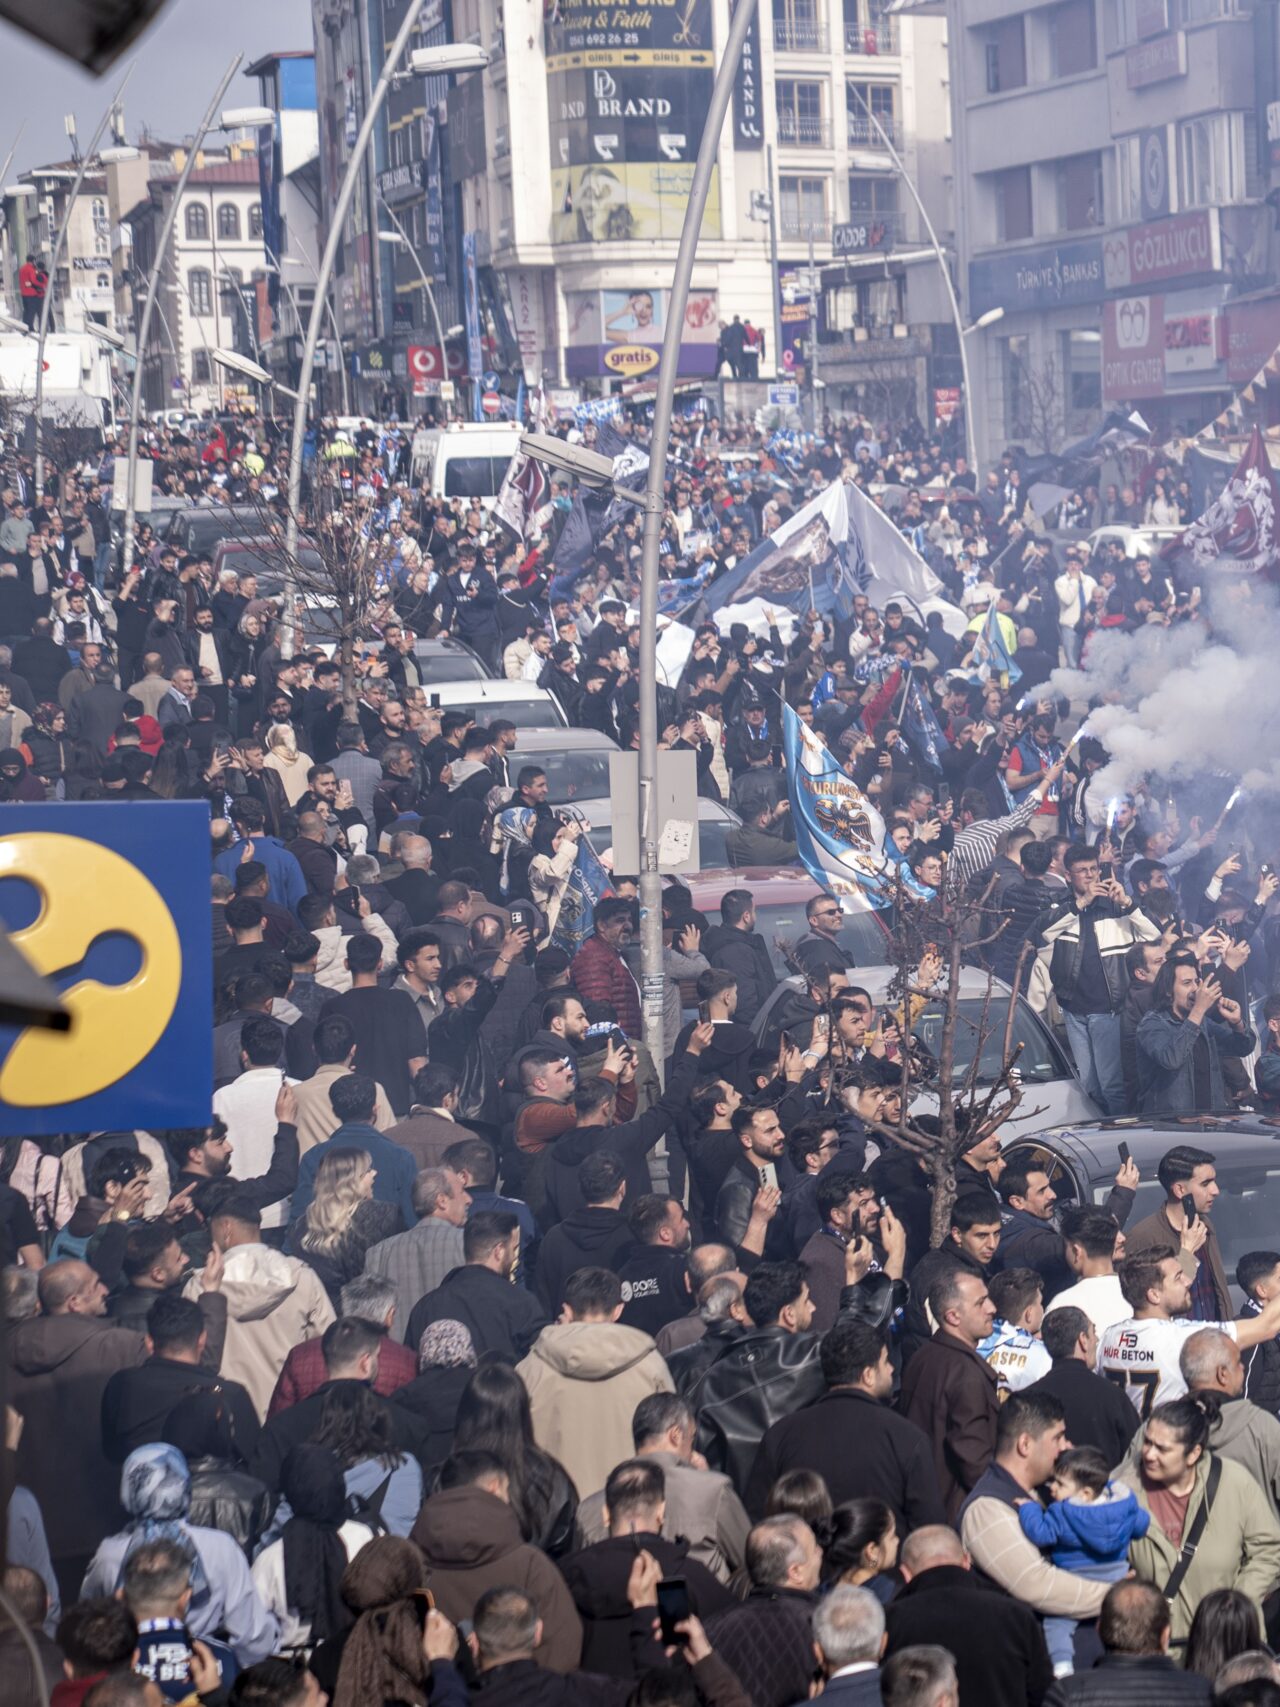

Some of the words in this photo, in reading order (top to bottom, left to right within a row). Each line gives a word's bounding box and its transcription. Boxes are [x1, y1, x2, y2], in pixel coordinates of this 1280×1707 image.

[623, 32, 639, 45] 25
[599, 98, 671, 117] BRAND
[1132, 218, 1208, 272] GÖZLÜKÇÜ
[610, 348, 652, 366] gratis
[1103, 1345, 1120, 1361] HÜR
[1121, 1348, 1154, 1362] BETON
